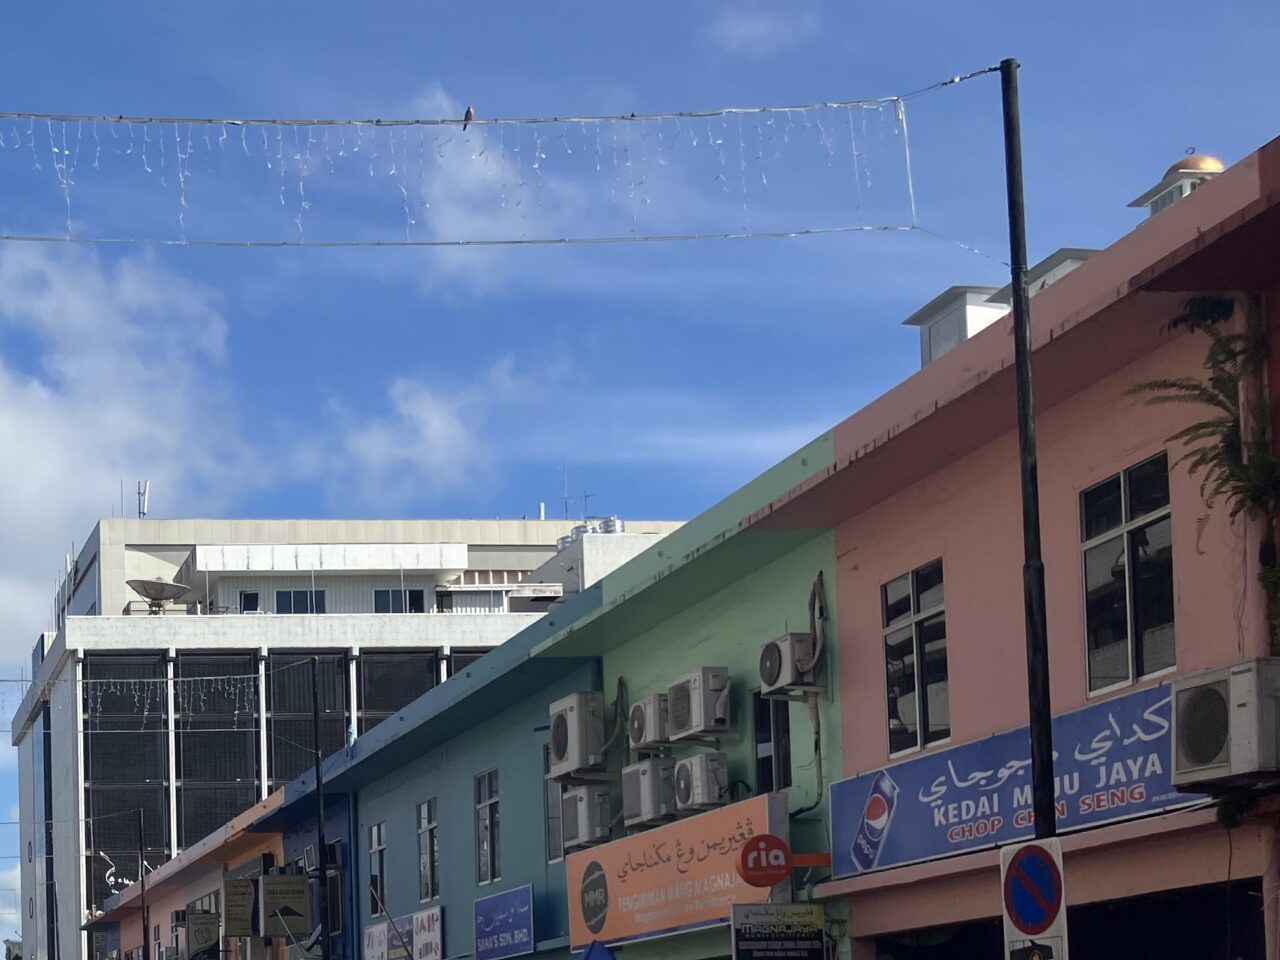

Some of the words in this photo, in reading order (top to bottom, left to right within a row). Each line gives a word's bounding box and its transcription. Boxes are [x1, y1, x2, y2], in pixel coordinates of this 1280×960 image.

[934, 795, 999, 827] KEDAI
[1013, 774, 1080, 809] MJU
[1095, 753, 1164, 789] JAYA
[949, 817, 1003, 843] CHOP
[1079, 784, 1145, 814] SENG
[748, 841, 786, 868] ria
[742, 923, 818, 934] MAGNAJAYA
